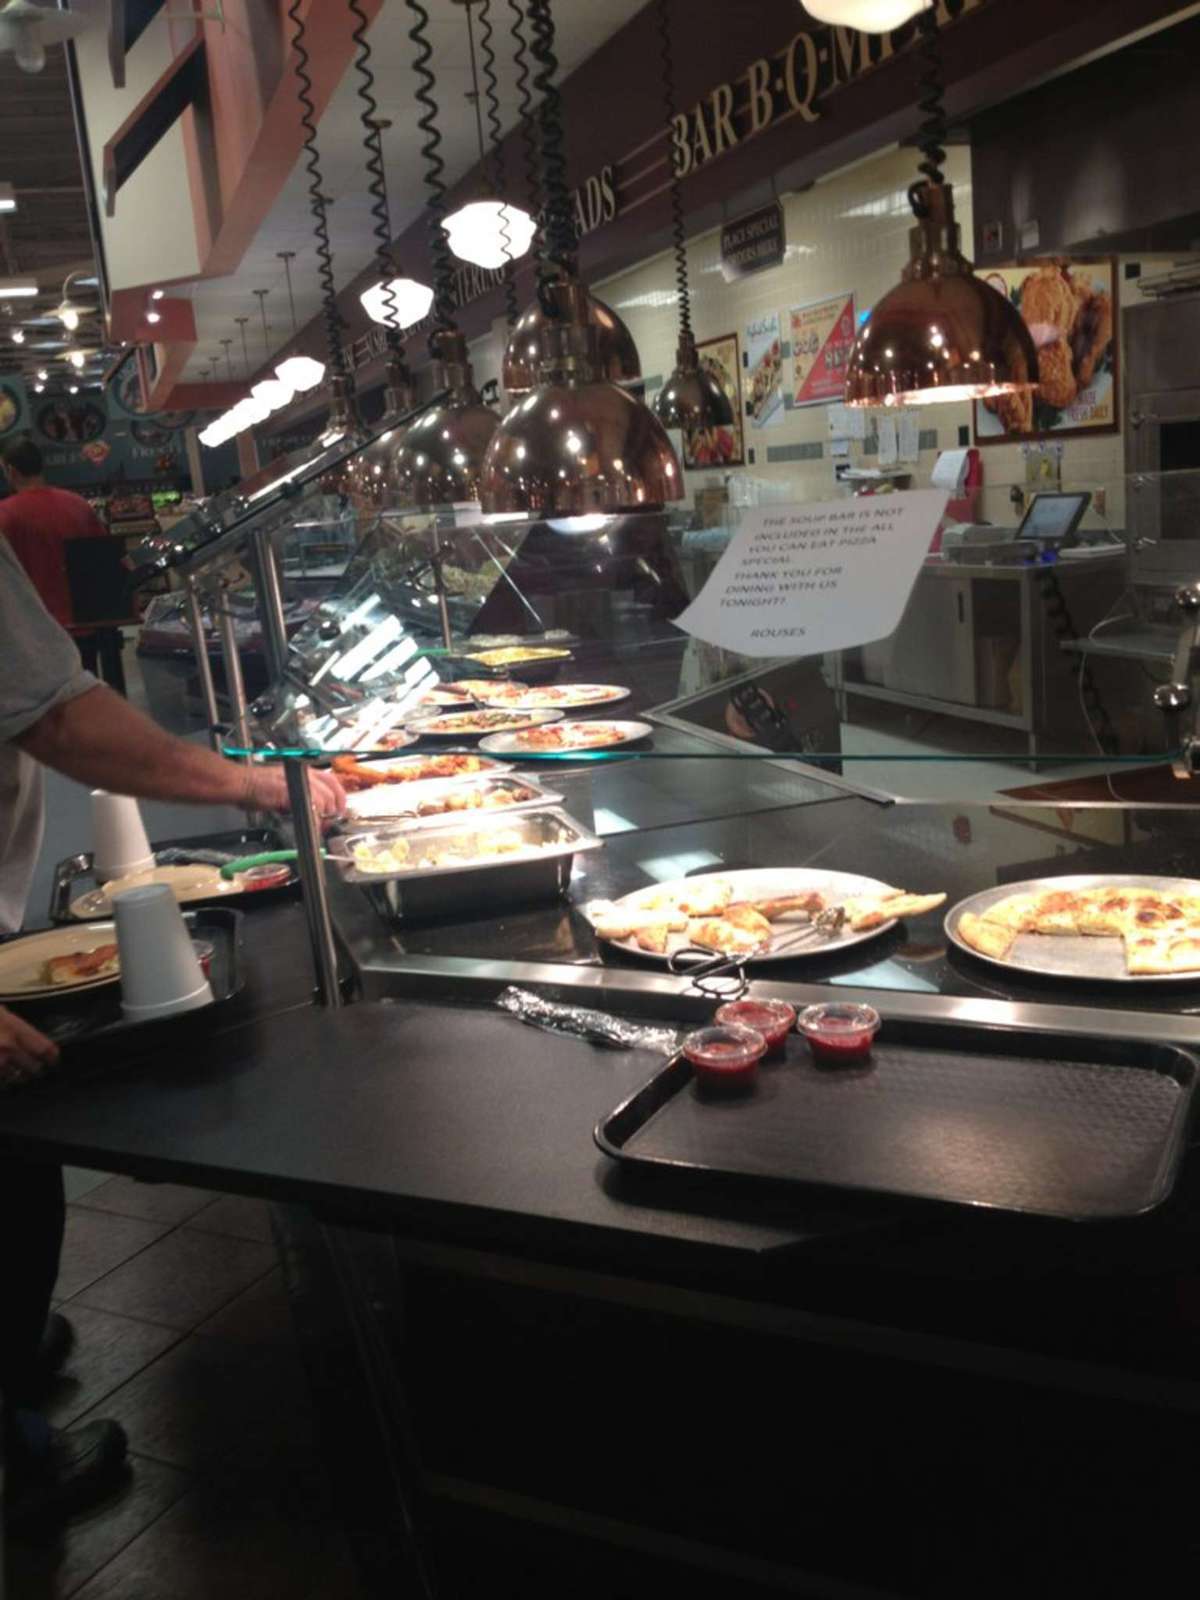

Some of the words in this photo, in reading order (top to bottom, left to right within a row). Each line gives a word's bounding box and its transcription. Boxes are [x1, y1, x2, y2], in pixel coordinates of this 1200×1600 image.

[763, 517, 786, 527] THE
[790, 514, 826, 525] SOUP
[829, 511, 856, 521] BAR
[858, 510, 871, 519] IS
[874, 507, 903, 518] NOT
[754, 529, 821, 542] INCLUDED
[823, 527, 839, 537] IN
[843, 525, 867, 534] THE
[872, 522, 895, 532] ALL
[749, 544, 777, 554] YOU
[779, 541, 808, 552] CAN
[811, 538, 836, 550] EAT
[839, 536, 877, 547] PIZZA
[735, 570, 777, 581] THANK
[782, 568, 812, 578] YOU
[814, 566, 843, 576] FOR
[725, 584, 775, 595] DINING
[778, 581, 817, 592] WITH
[819, 580, 838, 590] US
[749, 627, 807, 638] ROUSES
